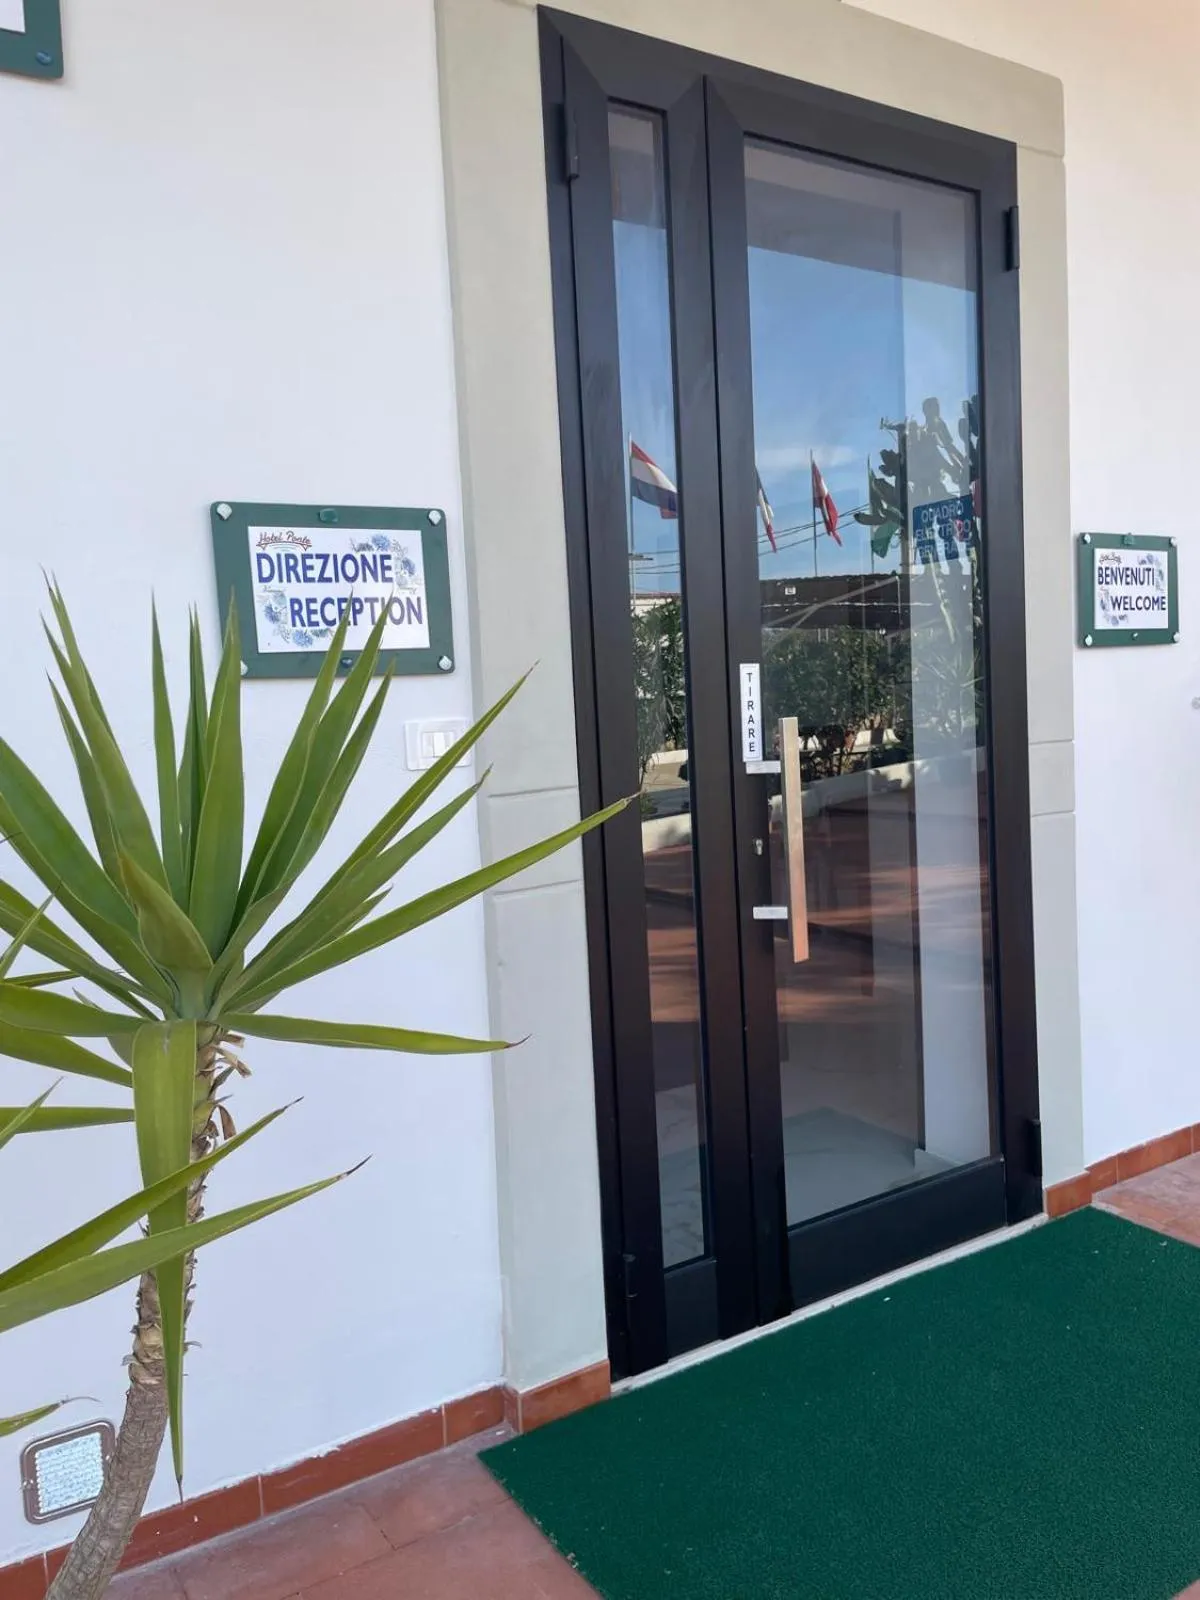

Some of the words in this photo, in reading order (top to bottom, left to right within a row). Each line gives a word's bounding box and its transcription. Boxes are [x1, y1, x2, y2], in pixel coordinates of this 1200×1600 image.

[921, 502, 964, 523] QUADRO
[259, 531, 283, 543] Hotel
[256, 553, 393, 583] DIREZIONE
[1097, 566, 1155, 586] BENVENUTI
[289, 597, 423, 628] RECEPTION
[1110, 596, 1166, 611] WELCOME
[746, 672, 756, 752] TIRARE
